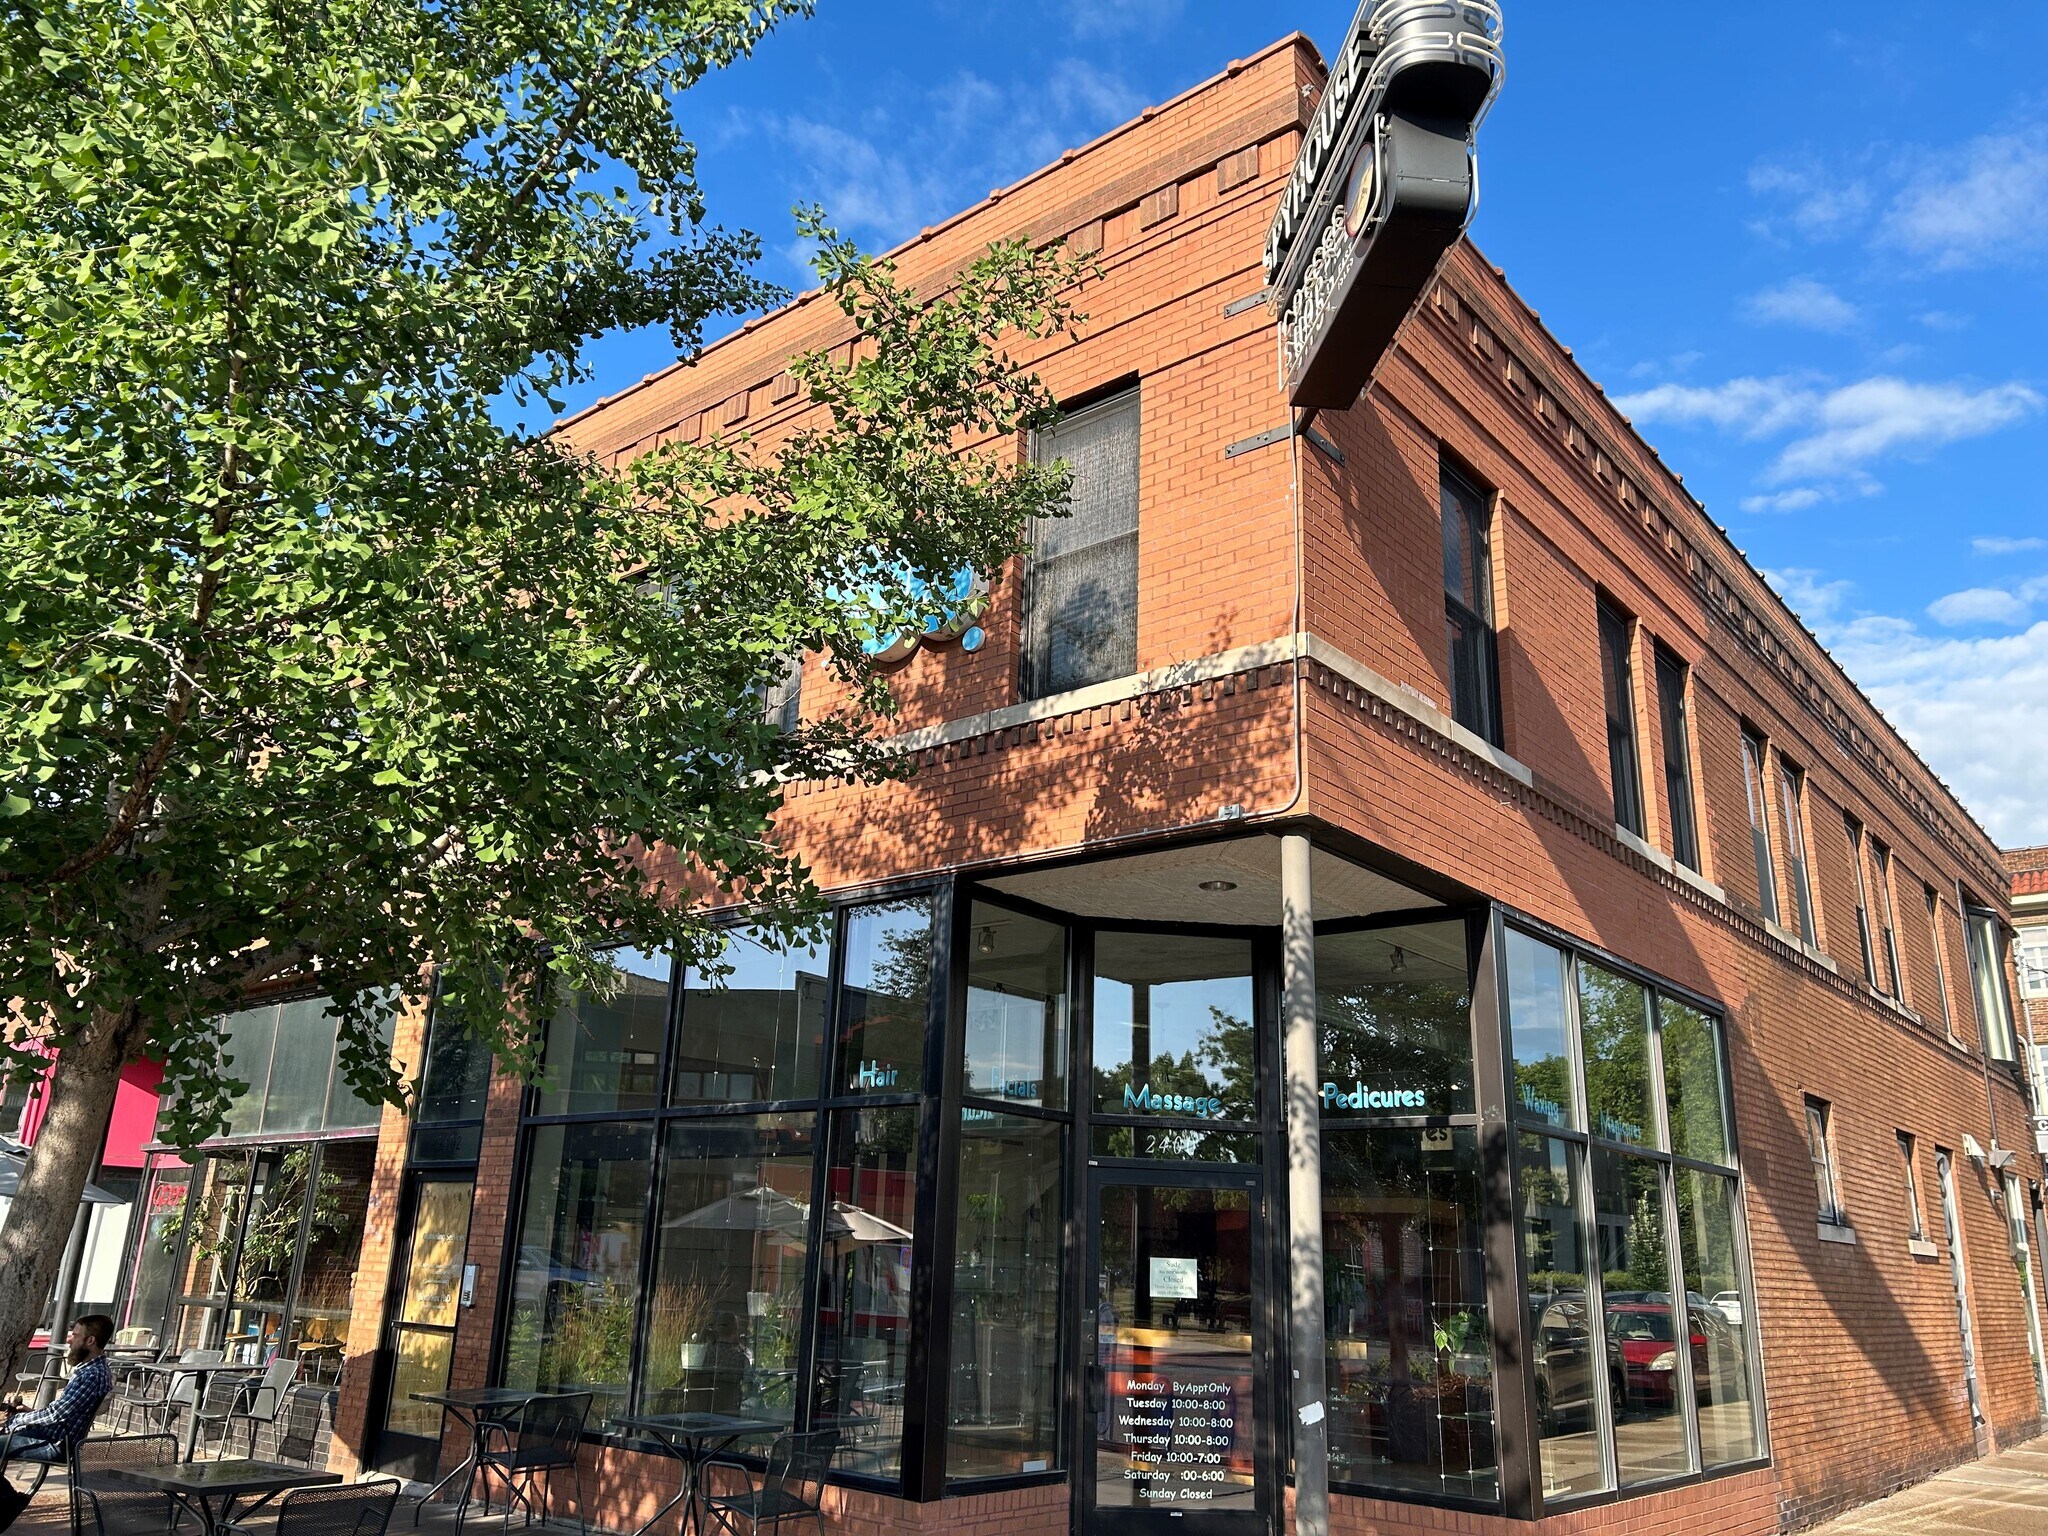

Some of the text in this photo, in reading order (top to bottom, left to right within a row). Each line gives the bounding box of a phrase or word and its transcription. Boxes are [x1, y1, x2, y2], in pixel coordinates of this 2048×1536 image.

[1262, 22, 1370, 286] SPYHOUSE
[858, 1059, 899, 1088] Hair
[1122, 1082, 1222, 1118] Massage
[1323, 1080, 1426, 1110] Pedicures
[1521, 1082, 1560, 1124] Waxing
[1126, 1380, 1165, 1393] Monday
[1126, 1397, 1226, 1411] Tuesday 10:00-8:00
[1118, 1415, 1234, 1429] Wednesday 10:00-8:00
[1123, 1433, 1229, 1446] Thursday 10:00-8:00
[1131, 1451, 1221, 1464] Friday 10:00-7:00
[1123, 1469, 1171, 1483] Saturday
[1139, 1488, 1213, 1501] Sunday Closed
